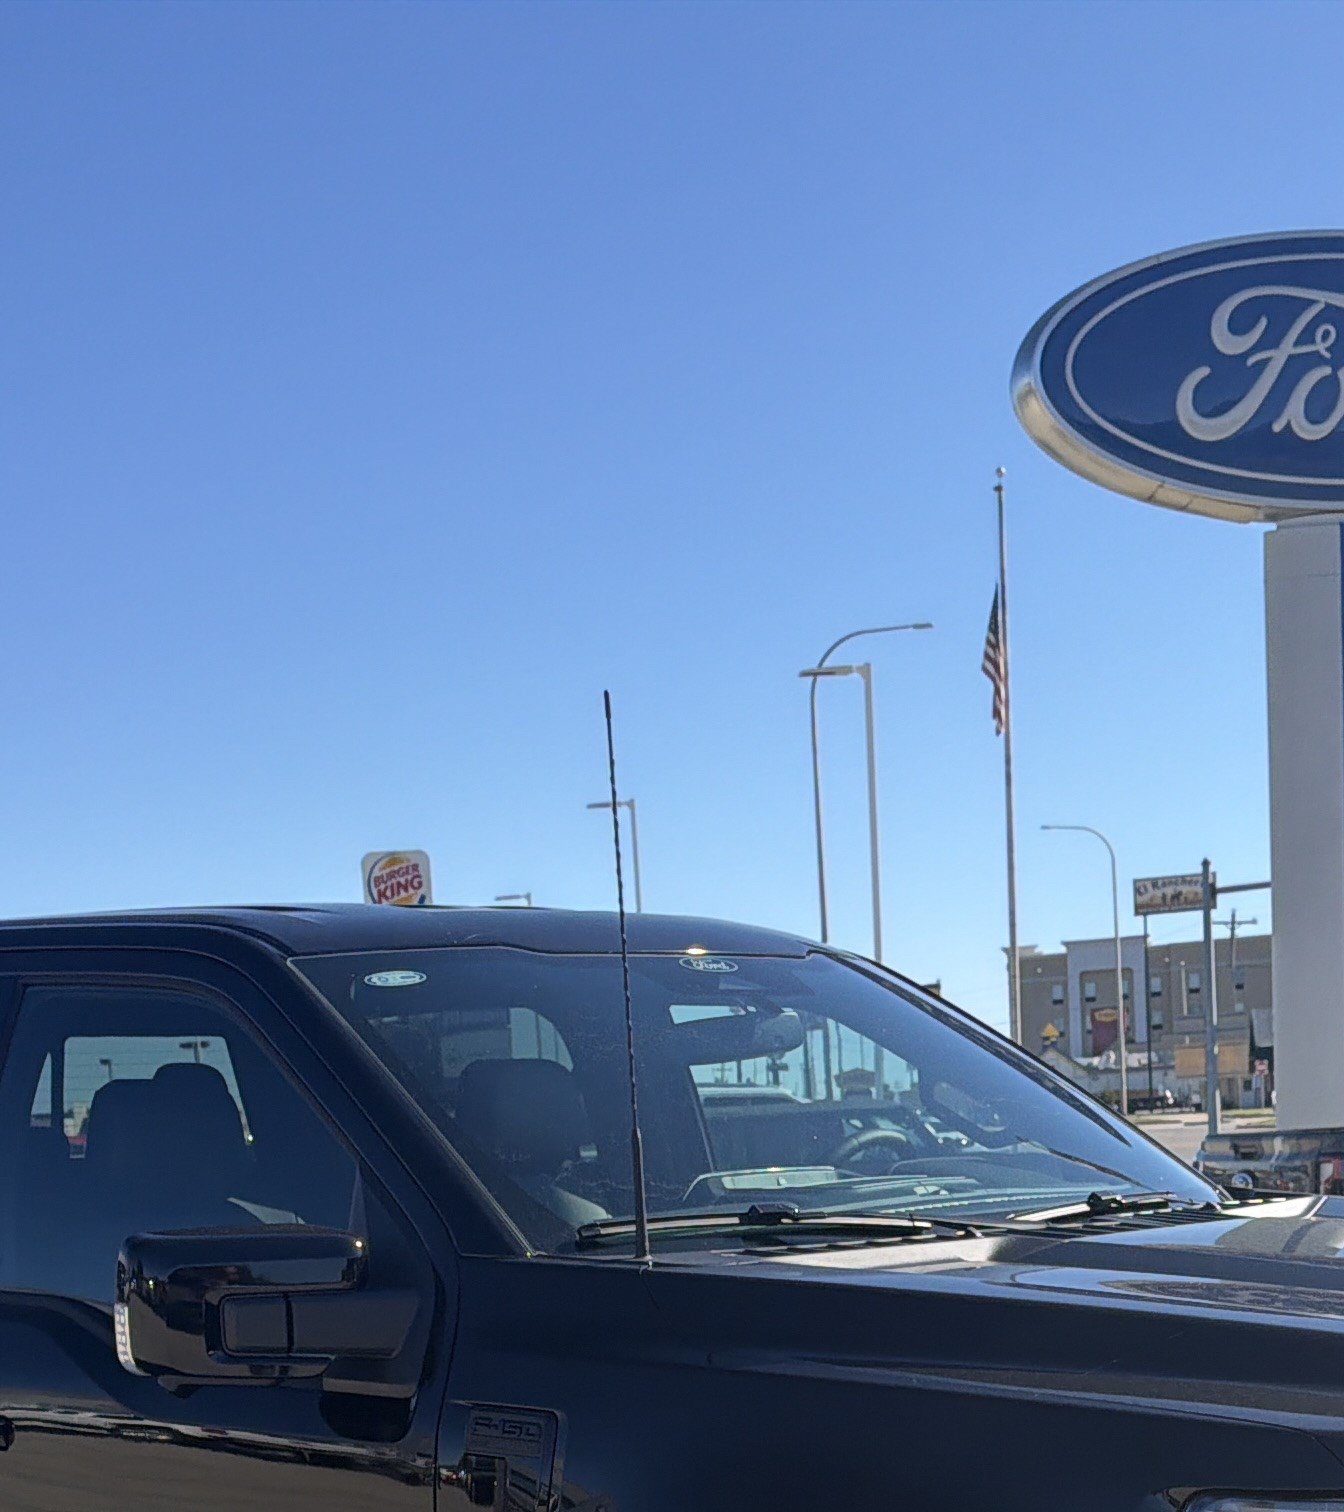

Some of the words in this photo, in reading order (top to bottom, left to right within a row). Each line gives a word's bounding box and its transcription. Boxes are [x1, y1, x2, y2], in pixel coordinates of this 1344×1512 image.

[374, 863, 419, 889] BURGER
[377, 874, 423, 904] KING
[1151, 876, 1208, 890] Rancher
